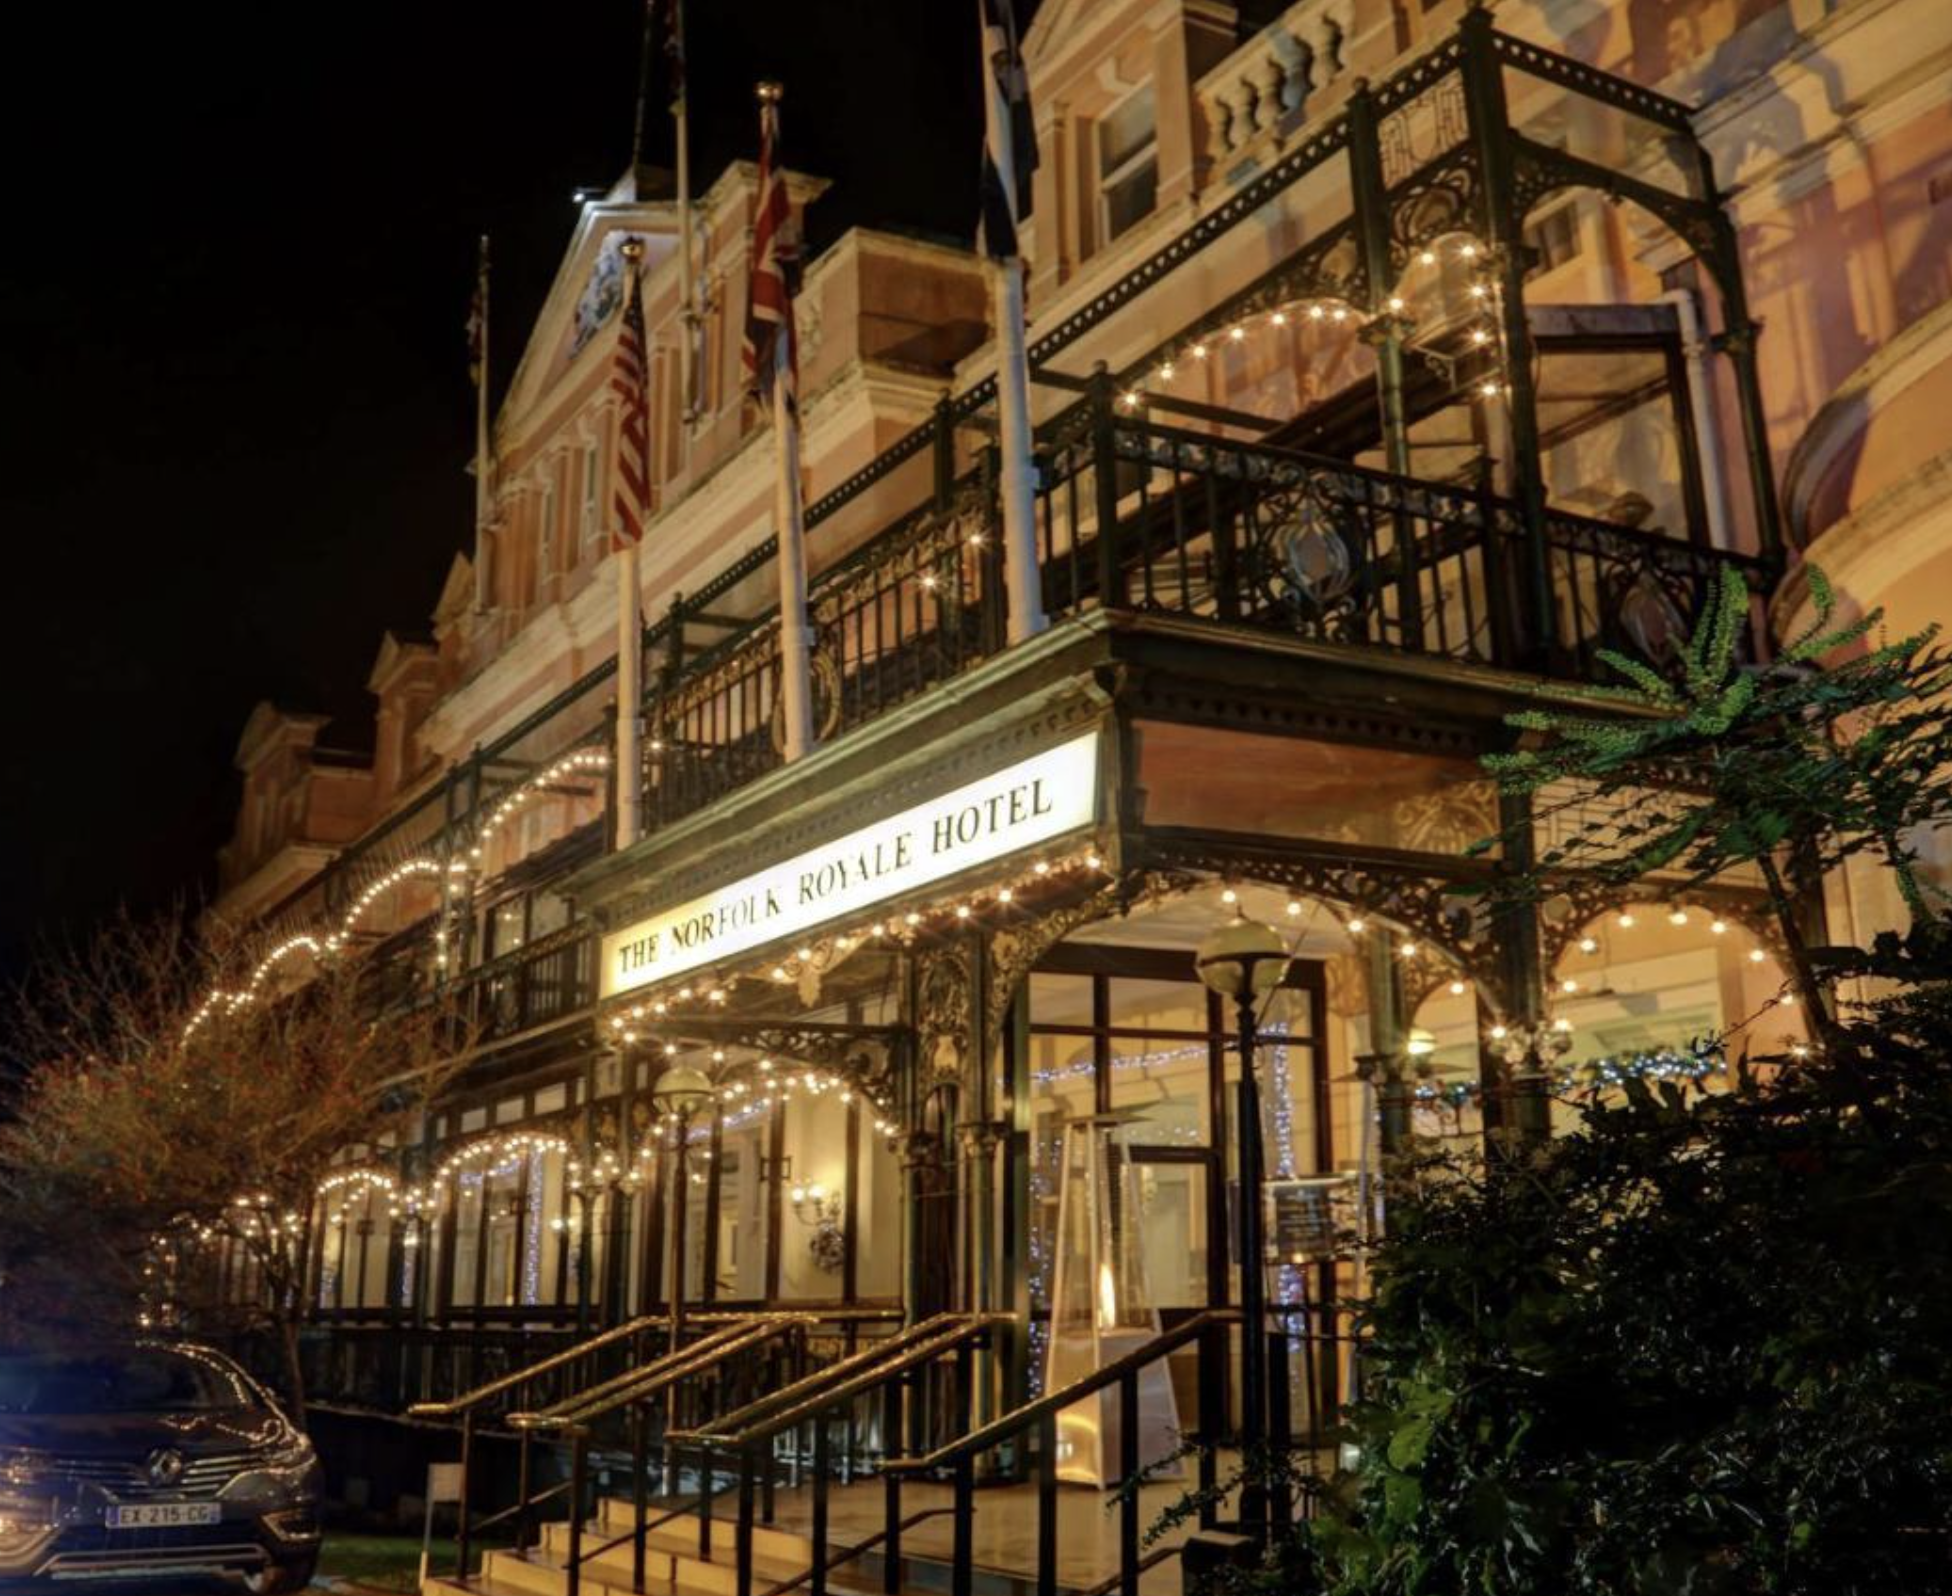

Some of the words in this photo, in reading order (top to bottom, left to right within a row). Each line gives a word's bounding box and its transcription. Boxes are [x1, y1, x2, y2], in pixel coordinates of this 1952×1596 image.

[619, 932, 661, 973] THE
[671, 885, 782, 956] NORFOLK
[798, 831, 912, 904] ROYALE
[931, 778, 1052, 854] HOTEL
